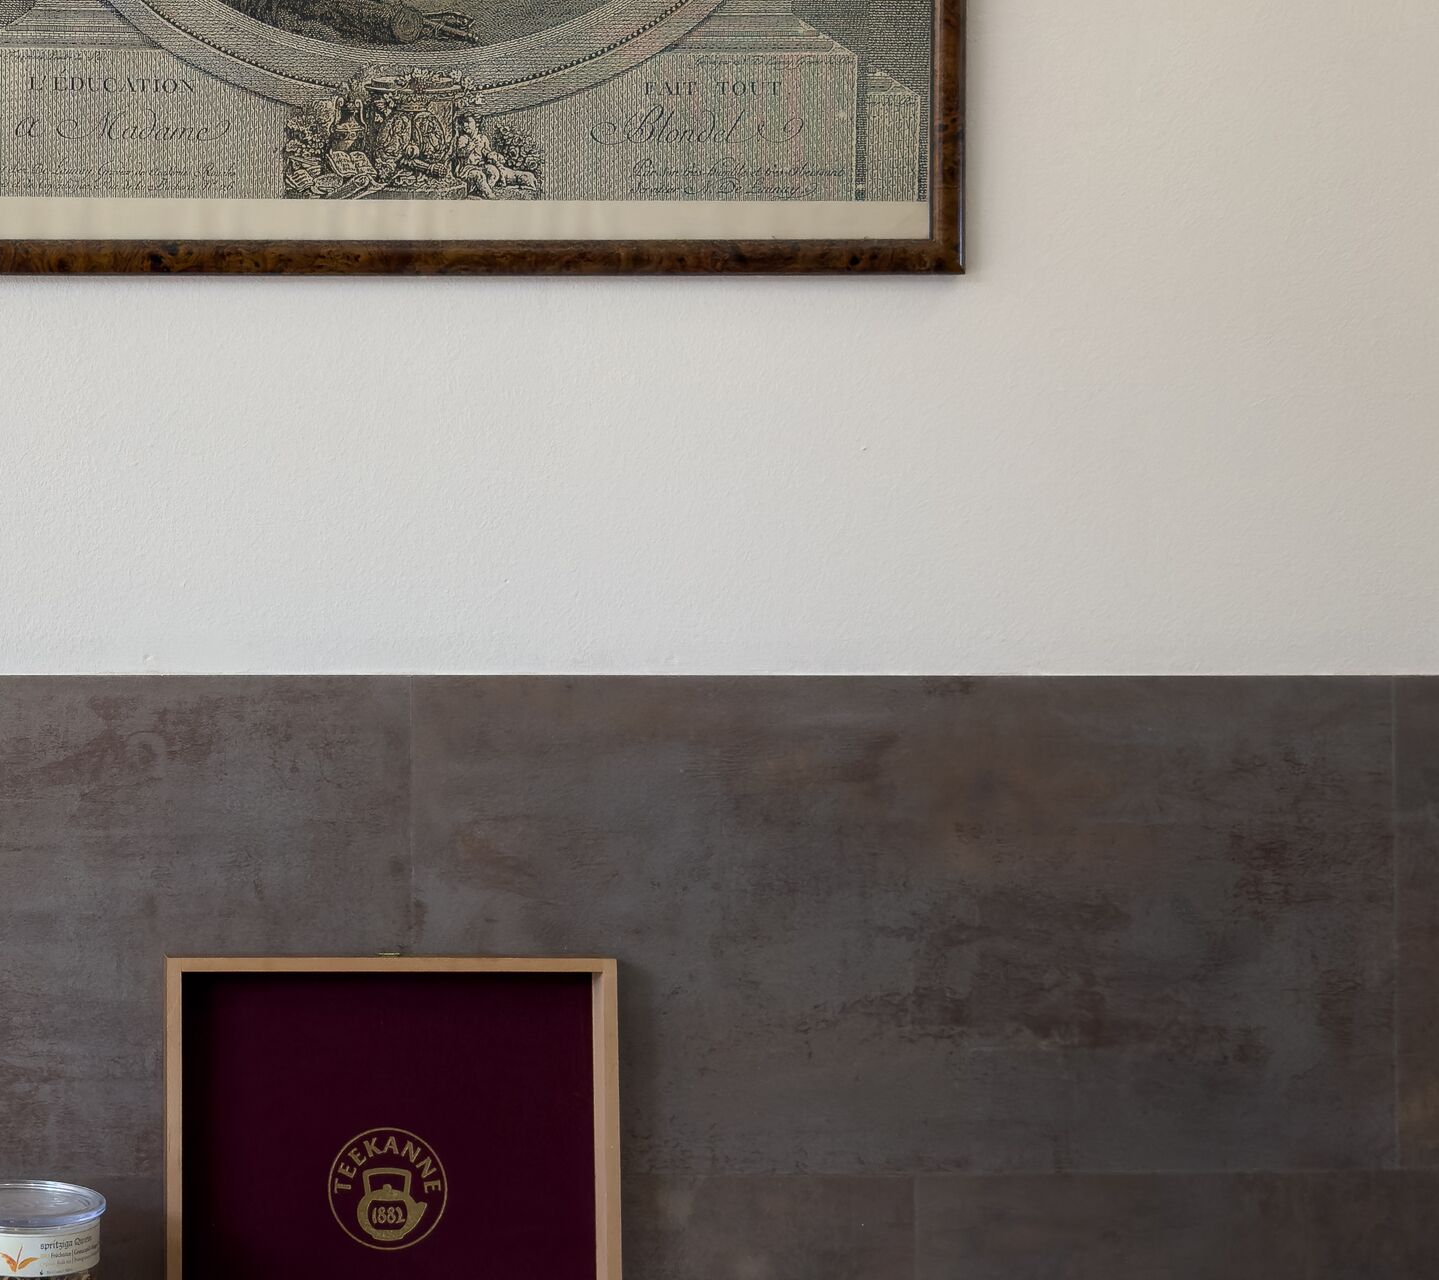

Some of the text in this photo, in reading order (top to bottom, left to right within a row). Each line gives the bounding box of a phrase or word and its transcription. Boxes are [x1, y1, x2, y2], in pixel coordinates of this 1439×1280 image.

[645, 81, 782, 96] FAIT TOUT
[334, 1135, 441, 1194] TEEKANNE
[371, 1206, 405, 1224] 1882
